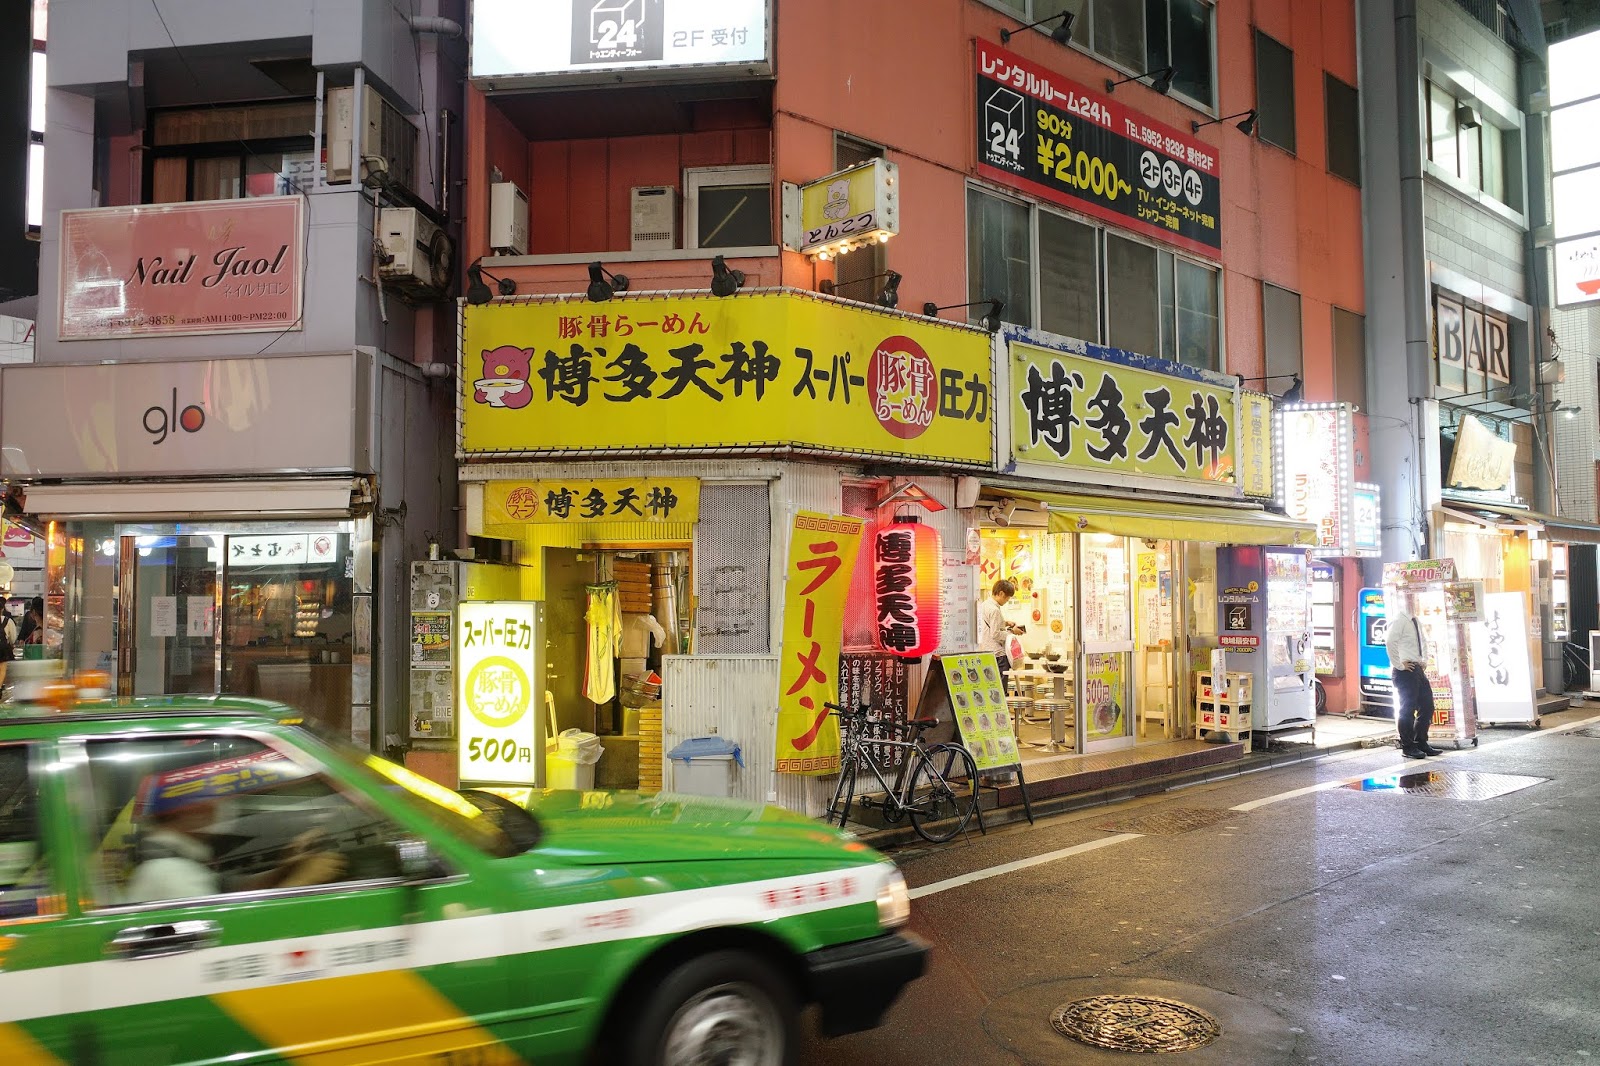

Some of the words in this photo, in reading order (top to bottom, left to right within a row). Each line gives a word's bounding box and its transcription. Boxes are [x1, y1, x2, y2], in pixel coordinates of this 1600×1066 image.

[597, 20, 637, 49] 24
[673, 30, 704, 47] 2F
[711, 27, 748, 46] 受付
[981, 51, 1112, 127] レンタルルーム24h
[990, 121, 1020, 160] 24
[1037, 109, 1072, 140] 90分
[1142, 157, 1160, 182] 2F
[1164, 165, 1181, 191] 3F
[1184, 174, 1201, 199] 4F
[809, 214, 872, 243] とんこつ
[125, 255, 196, 286] Nail
[201, 245, 289, 288] Jaol
[223, 282, 290, 298] ネイルサロン
[558, 312, 711, 340] 豚骨らーめん
[1442, 304, 1508, 380] BAR
[538, 341, 781, 406] 博多天神
[794, 347, 865, 405] スーパー
[938, 368, 988, 424] 圧力
[874, 349, 934, 396] 豚骨
[142, 387, 205, 444] glo
[874, 394, 934, 427] らーめん
[1019, 359, 1229, 472] 博多天神
[544, 487, 678, 519] 博多天神
[1322, 518, 1335, 546] B1F
[875, 532, 919, 653] 博多天神
[464, 618, 532, 650] スーパー圧力
[1231, 617, 1244, 627] 24
[786, 541, 842, 751] ラーメン
[477, 670, 518, 696] 豚骨
[435, 706, 452, 718] BNE
[473, 694, 526, 714] らーめん
[468, 737, 532, 763] 500円
